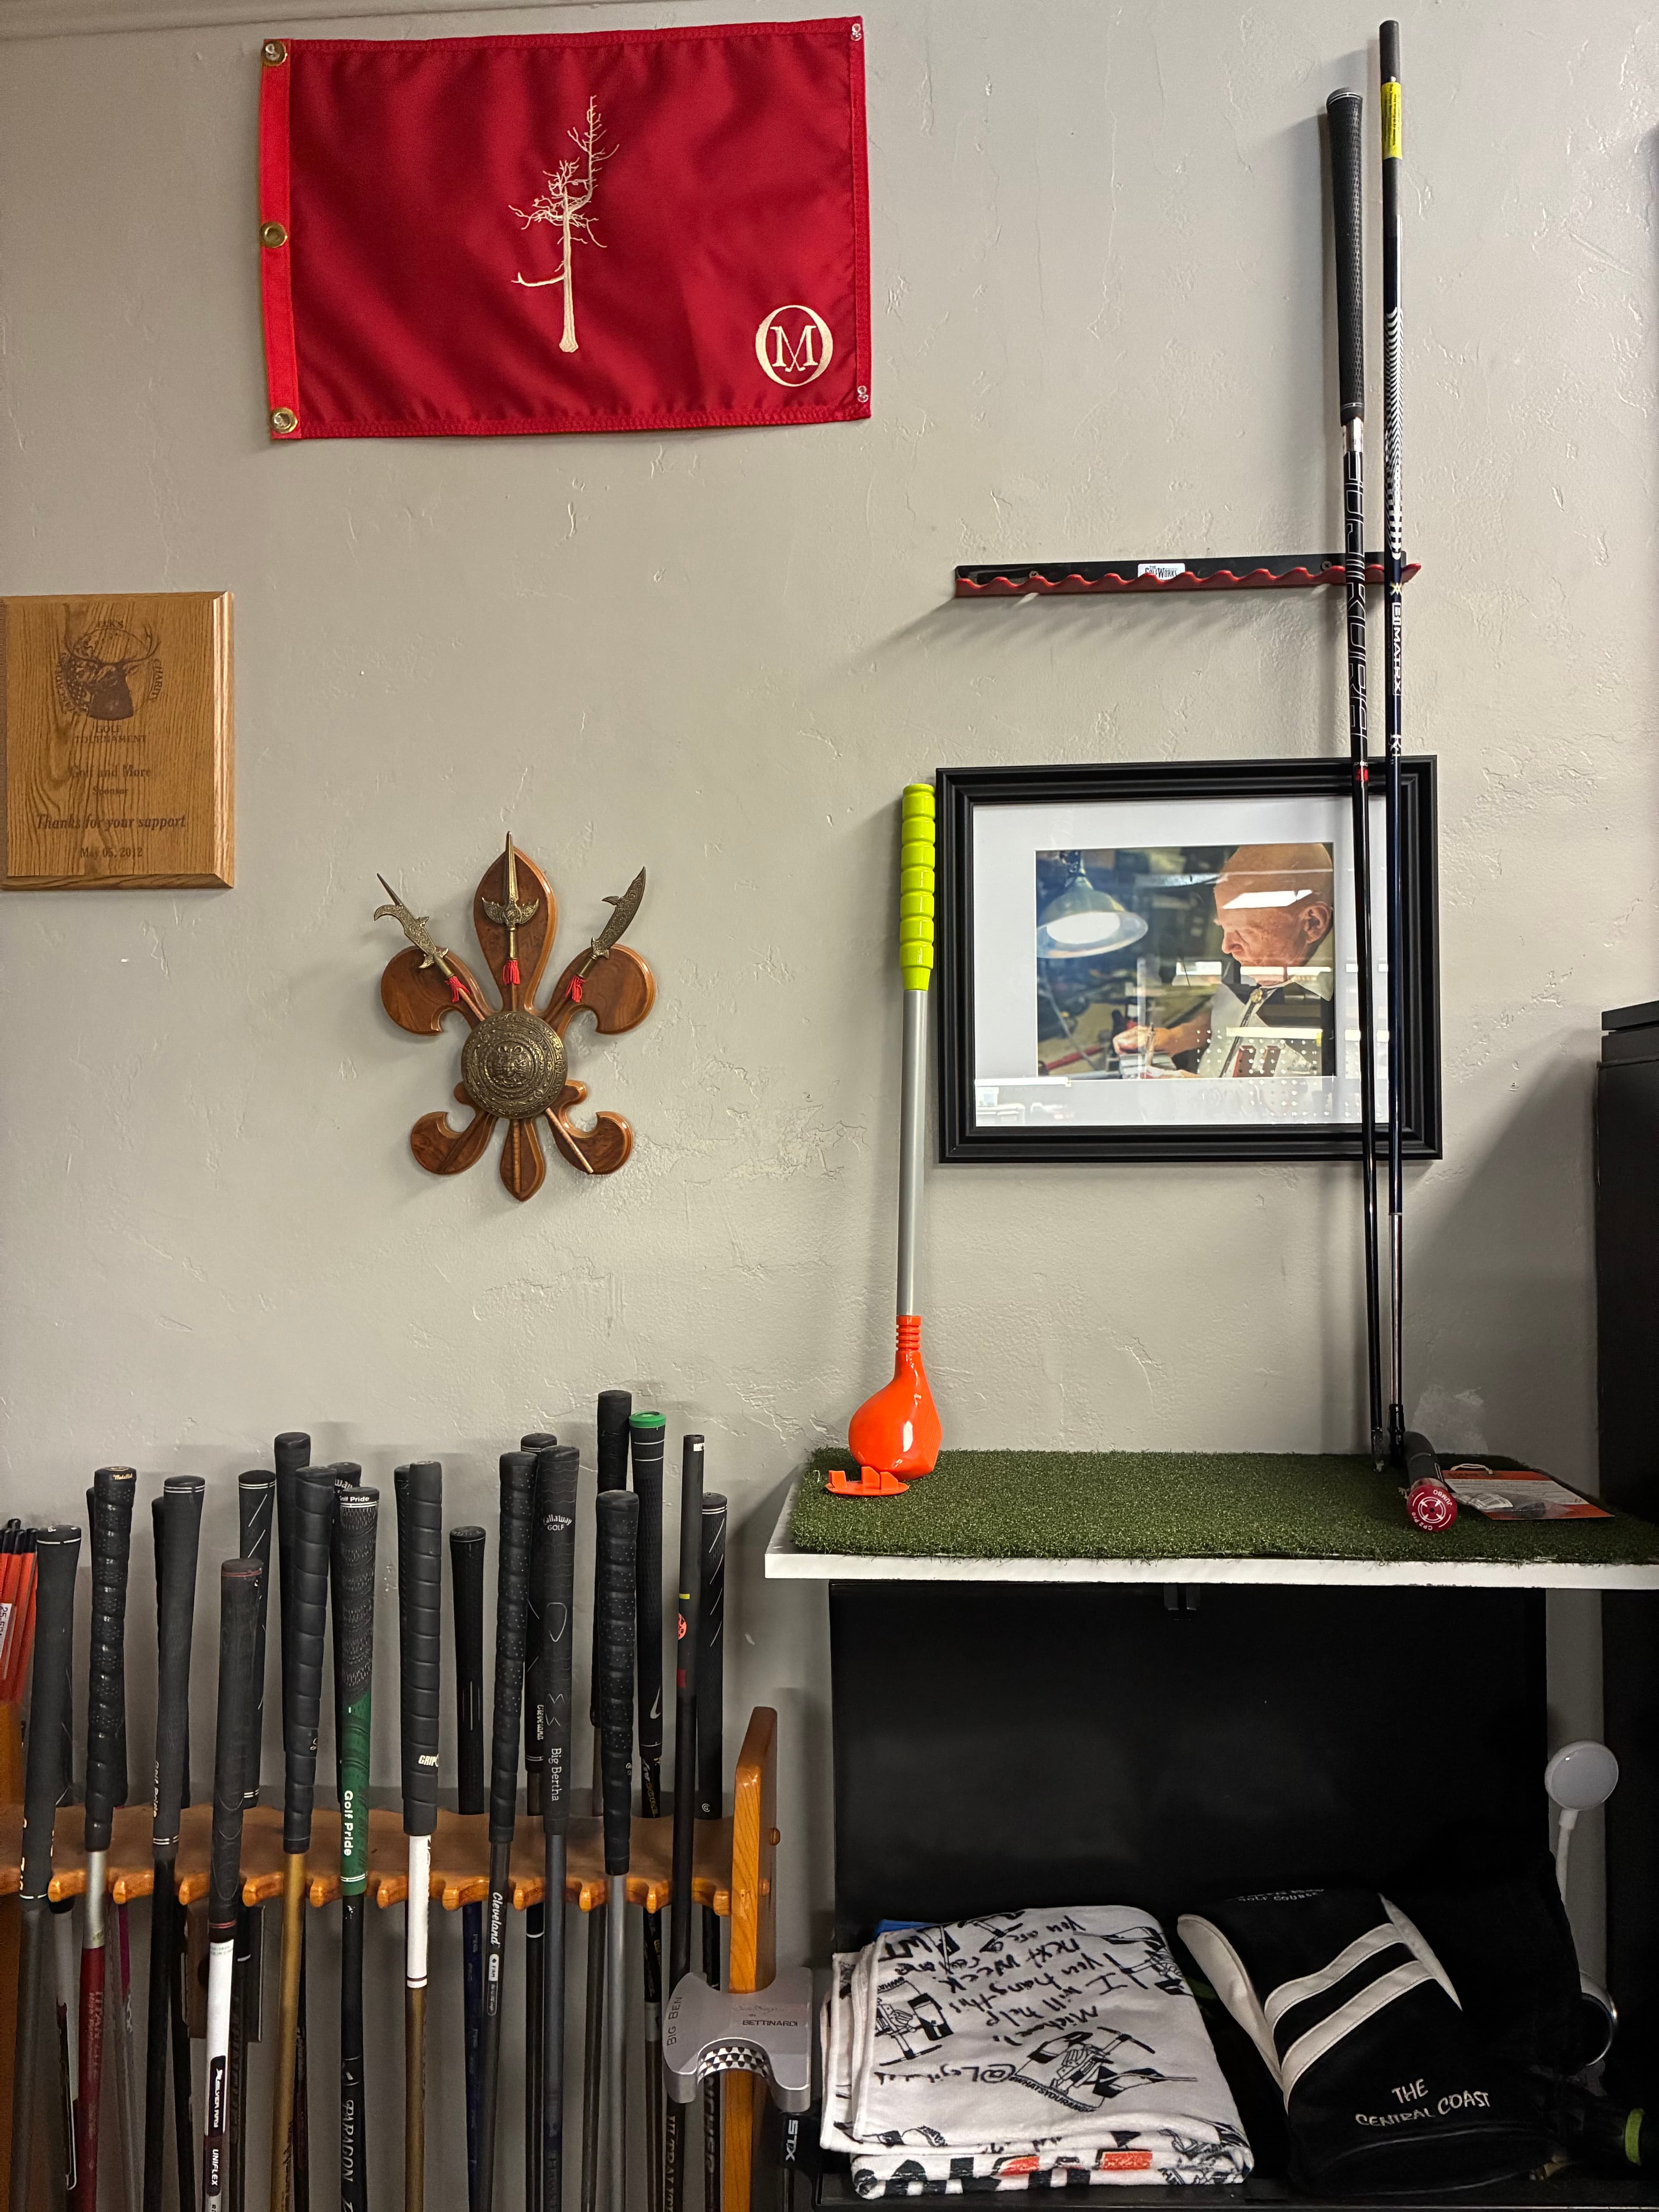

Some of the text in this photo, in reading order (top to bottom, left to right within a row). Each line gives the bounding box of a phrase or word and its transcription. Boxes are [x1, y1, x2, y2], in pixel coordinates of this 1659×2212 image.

[36, 813, 187, 832] Thanks for your support
[1433, 1489, 1452, 1506] JUMBO
[543, 1513, 572, 1526] Callaway
[1419, 1522, 1433, 1531] CP2
[548, 1748, 562, 1802] Big Bertha
[343, 1790, 354, 1856] Golf Pride
[490, 1892, 503, 1945] Cleveland
[1026, 1938, 1080, 1969] next
[988, 1973, 1062, 1996] hang
[949, 1993, 997, 2013] this
[1042, 1987, 1082, 2012] will
[667, 1997, 682, 2046] BIG BEN
[985, 2007, 1045, 2027] help
[1391, 2078, 1429, 2104] THE
[1354, 2090, 1491, 2126] CENTRAL COAST
[785, 2120, 798, 2161] STX
[211, 2148, 219, 2186] UNIFLEX
